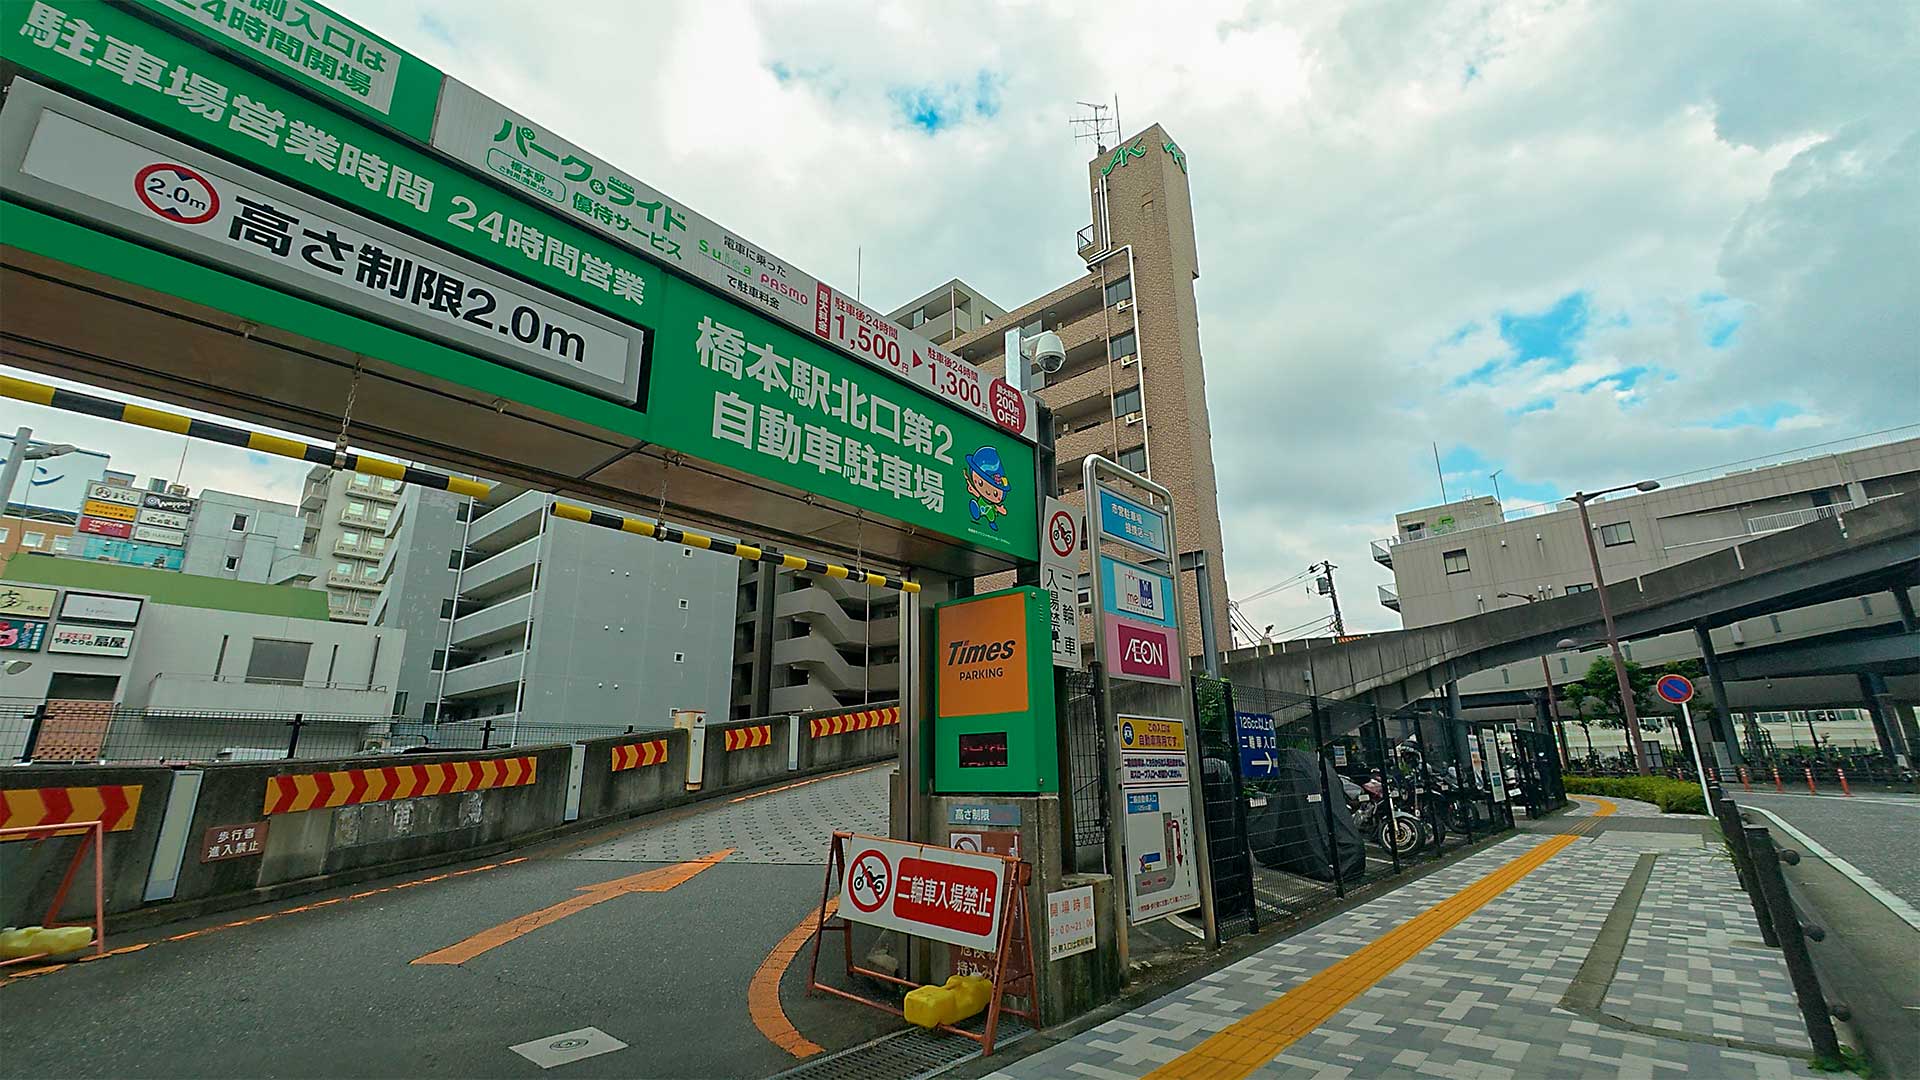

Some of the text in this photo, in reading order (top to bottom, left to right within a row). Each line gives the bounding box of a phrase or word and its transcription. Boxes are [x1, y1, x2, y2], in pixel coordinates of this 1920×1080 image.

[172, 0, 372, 97] 4時間開場
[19, 0, 646, 306] 駐車場営業時間 24時間営業
[147, 176, 207, 212] 2.0m
[572, 191, 682, 260] 優待サービス
[698, 239, 809, 306] Suica PASMO
[723, 235, 786, 278] 電車に乗った
[228, 195, 585, 363] 高さ制限2.0m
[727, 274, 781, 311] で駐車料金
[696, 315, 954, 465] 橋本駅北口第2
[997, 409, 1020, 430] OFF!
[711, 390, 945, 514] 自動車駐車場
[1061, 573, 1077, 658] 二輪車
[947, 639, 1016, 667] Times
[959, 667, 1004, 681] PARKING
[217, 827, 256, 844] 歩行者
[955, 808, 990, 821] 高さ制限
[207, 840, 259, 859] 進入禁止
[897, 875, 992, 918] 二輪車入場禁止
